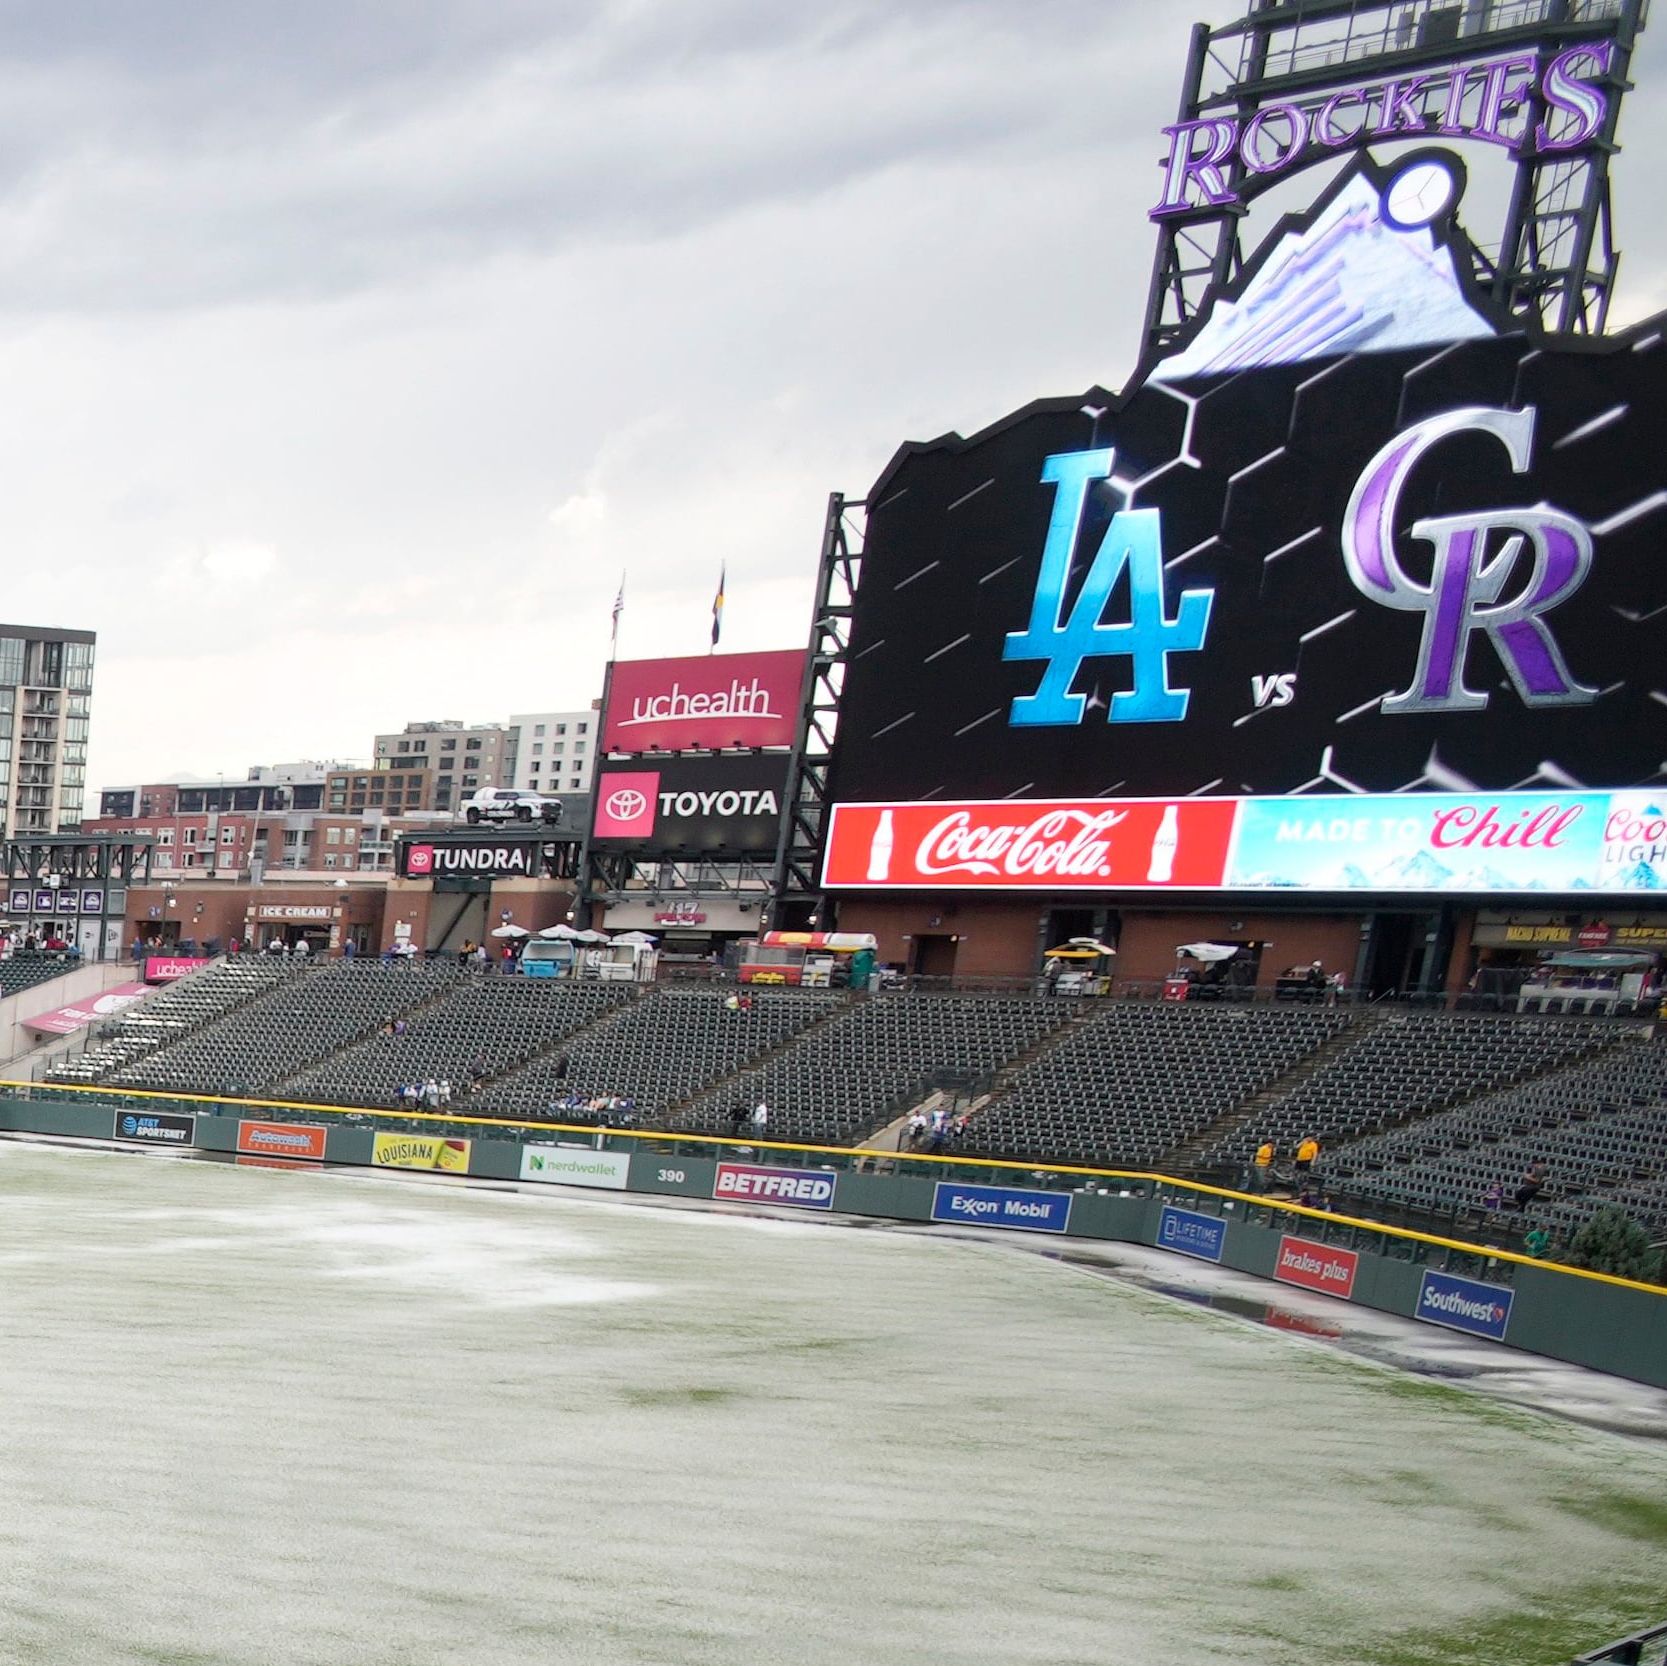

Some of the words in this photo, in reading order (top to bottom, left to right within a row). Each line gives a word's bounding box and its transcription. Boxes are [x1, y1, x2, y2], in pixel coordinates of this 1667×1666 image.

[1148, 40, 1612, 217] ROCKIES
[1342, 406, 1599, 715] CR
[1002, 447, 1215, 726] LA
[632, 677, 770, 721] uchealth
[658, 789, 778, 817] TOYOTA
[1275, 818, 1371, 842] MADE
[1379, 818, 1422, 842] TO
[1430, 803, 1584, 849] Chill
[914, 809, 1129, 876] Coca-Cola
[432, 848, 524, 870] TUNDRA
[263, 906, 283, 916] ICE
[285, 906, 328, 917] CREAM
[1616, 927, 1667, 938] SUPE
[136, 1125, 187, 1140] SPORTSNET
[137, 1118, 160, 1128] AT&T
[249, 1129, 311, 1148] Autowash
[377, 1142, 433, 1164] LOUISIANA
[547, 1159, 616, 1176] nerdwallet
[657, 1168, 685, 1183] 390
[717, 1171, 831, 1201] BETFRED
[951, 1195, 998, 1216] Exxon
[1004, 1199, 1051, 1219] Mobil
[1175, 1218, 1219, 1244] LIFETIME
[1281, 1248, 1321, 1274] brakes
[1322, 1259, 1349, 1281] plus
[1423, 1285, 1494, 1322] Southwest
